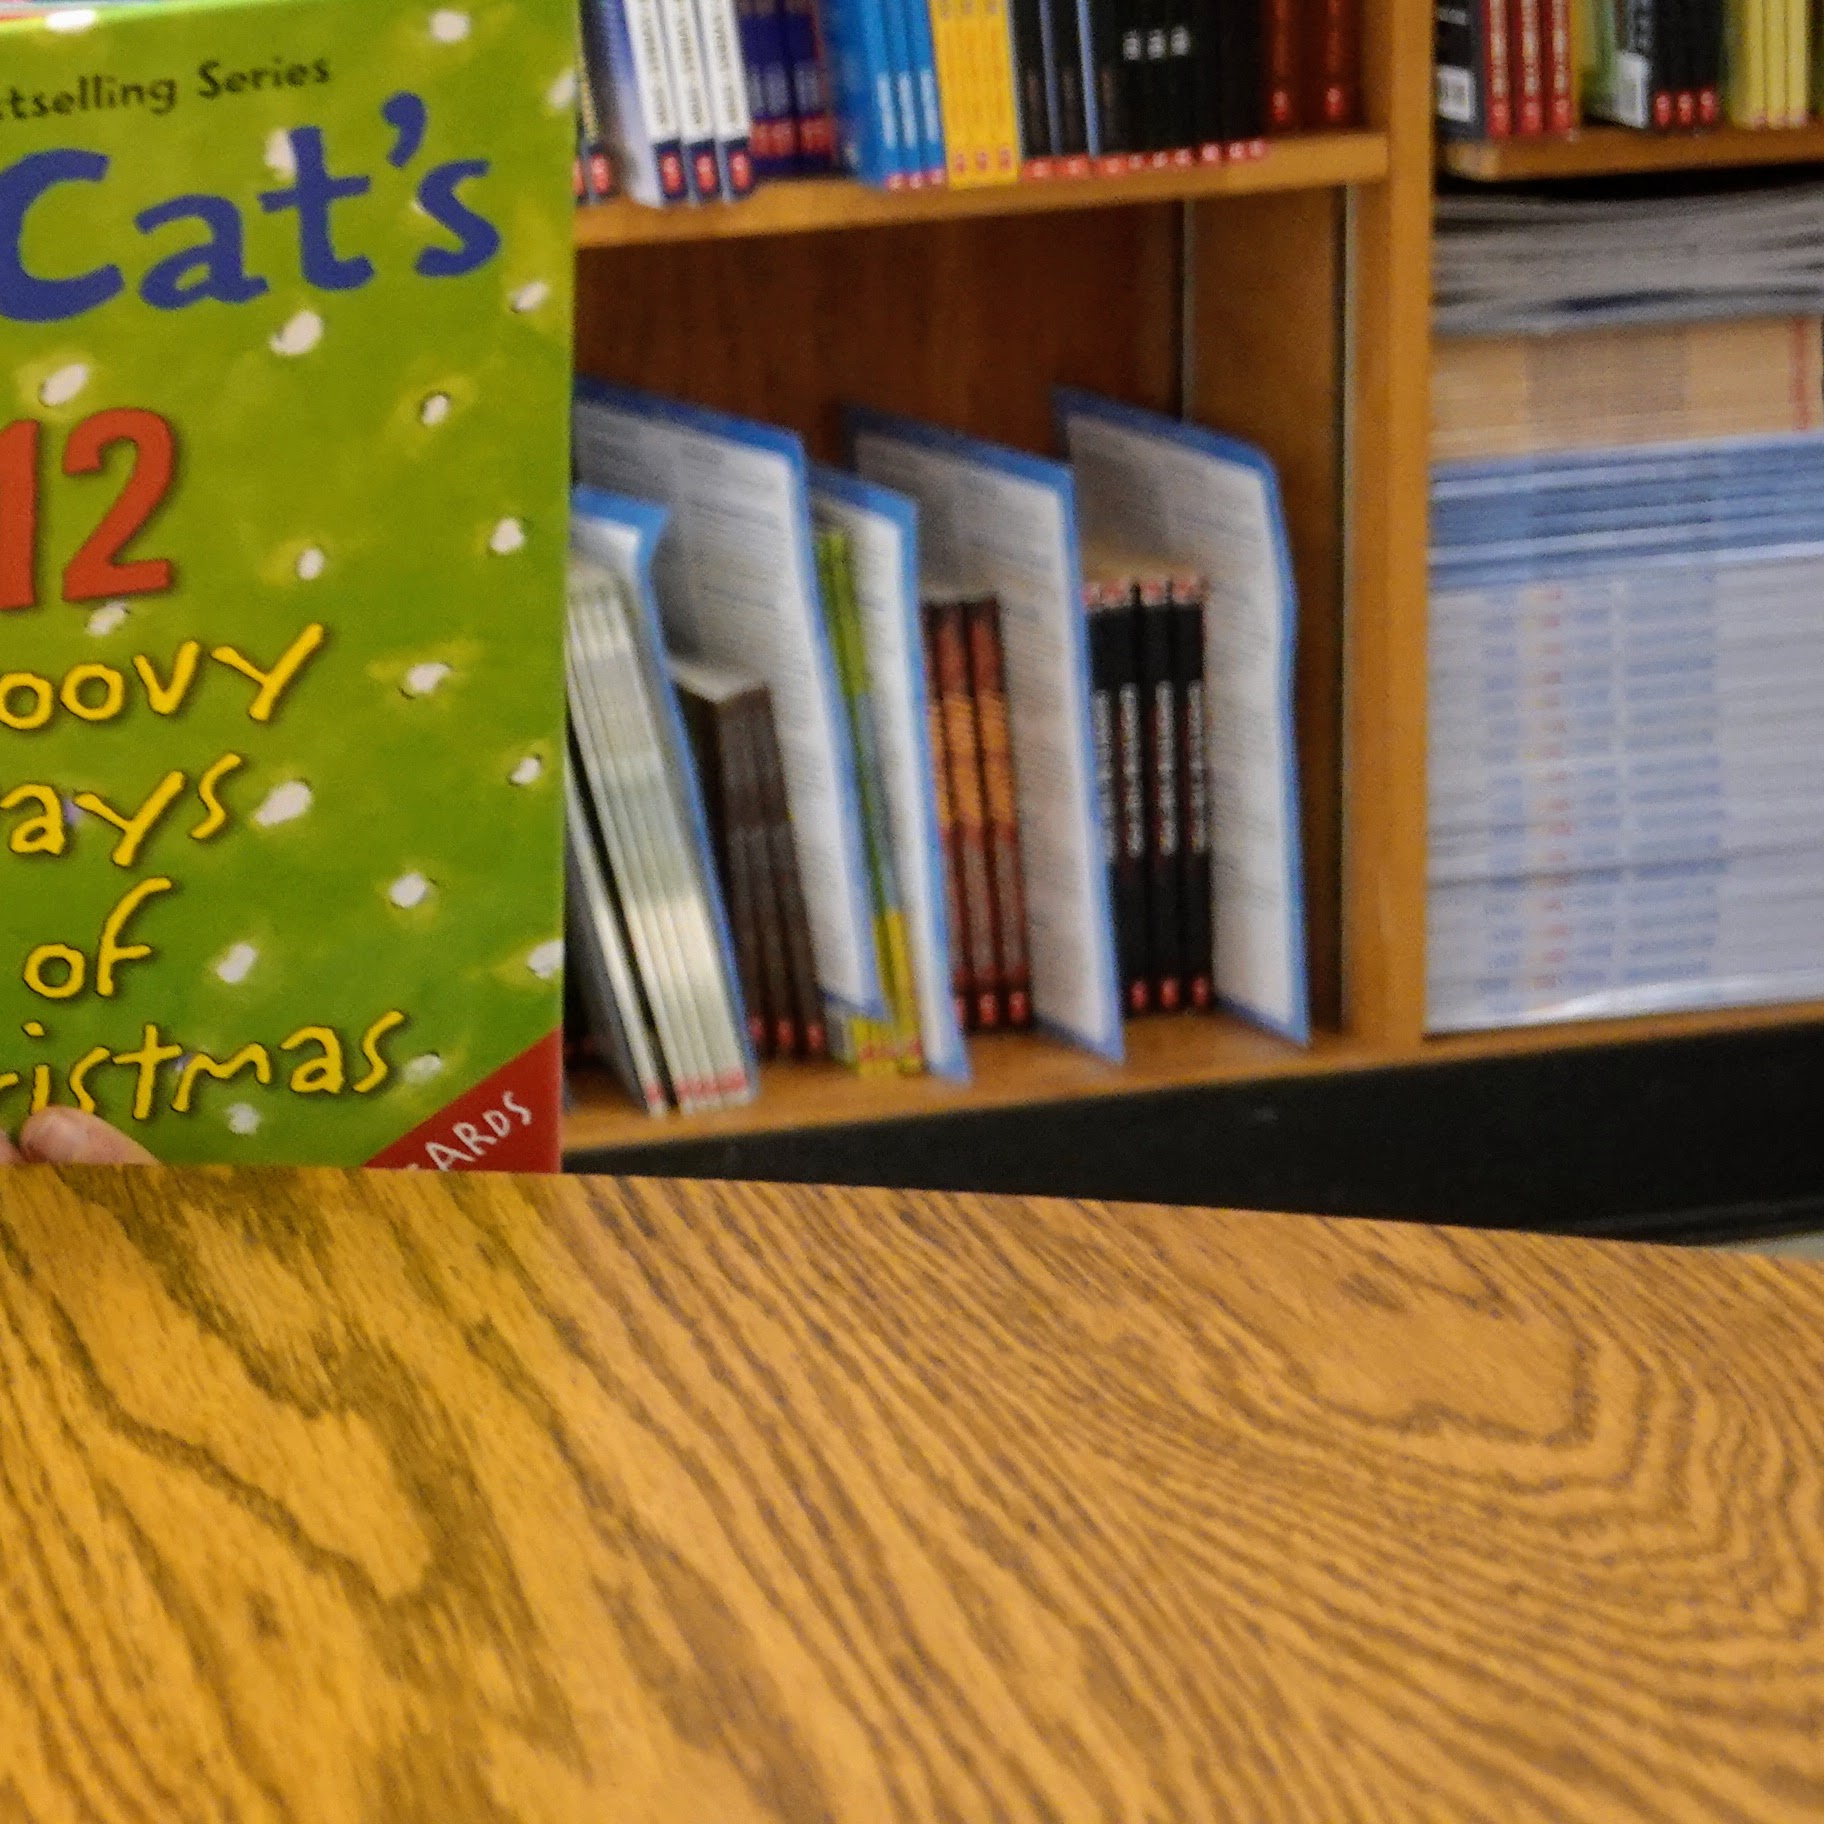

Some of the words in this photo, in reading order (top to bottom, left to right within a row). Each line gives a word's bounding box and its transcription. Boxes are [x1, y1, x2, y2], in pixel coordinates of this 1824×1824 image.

[196, 55, 332, 97] Series
[23, 877, 174, 999] of
[406, 1089, 533, 1172] ARDS
